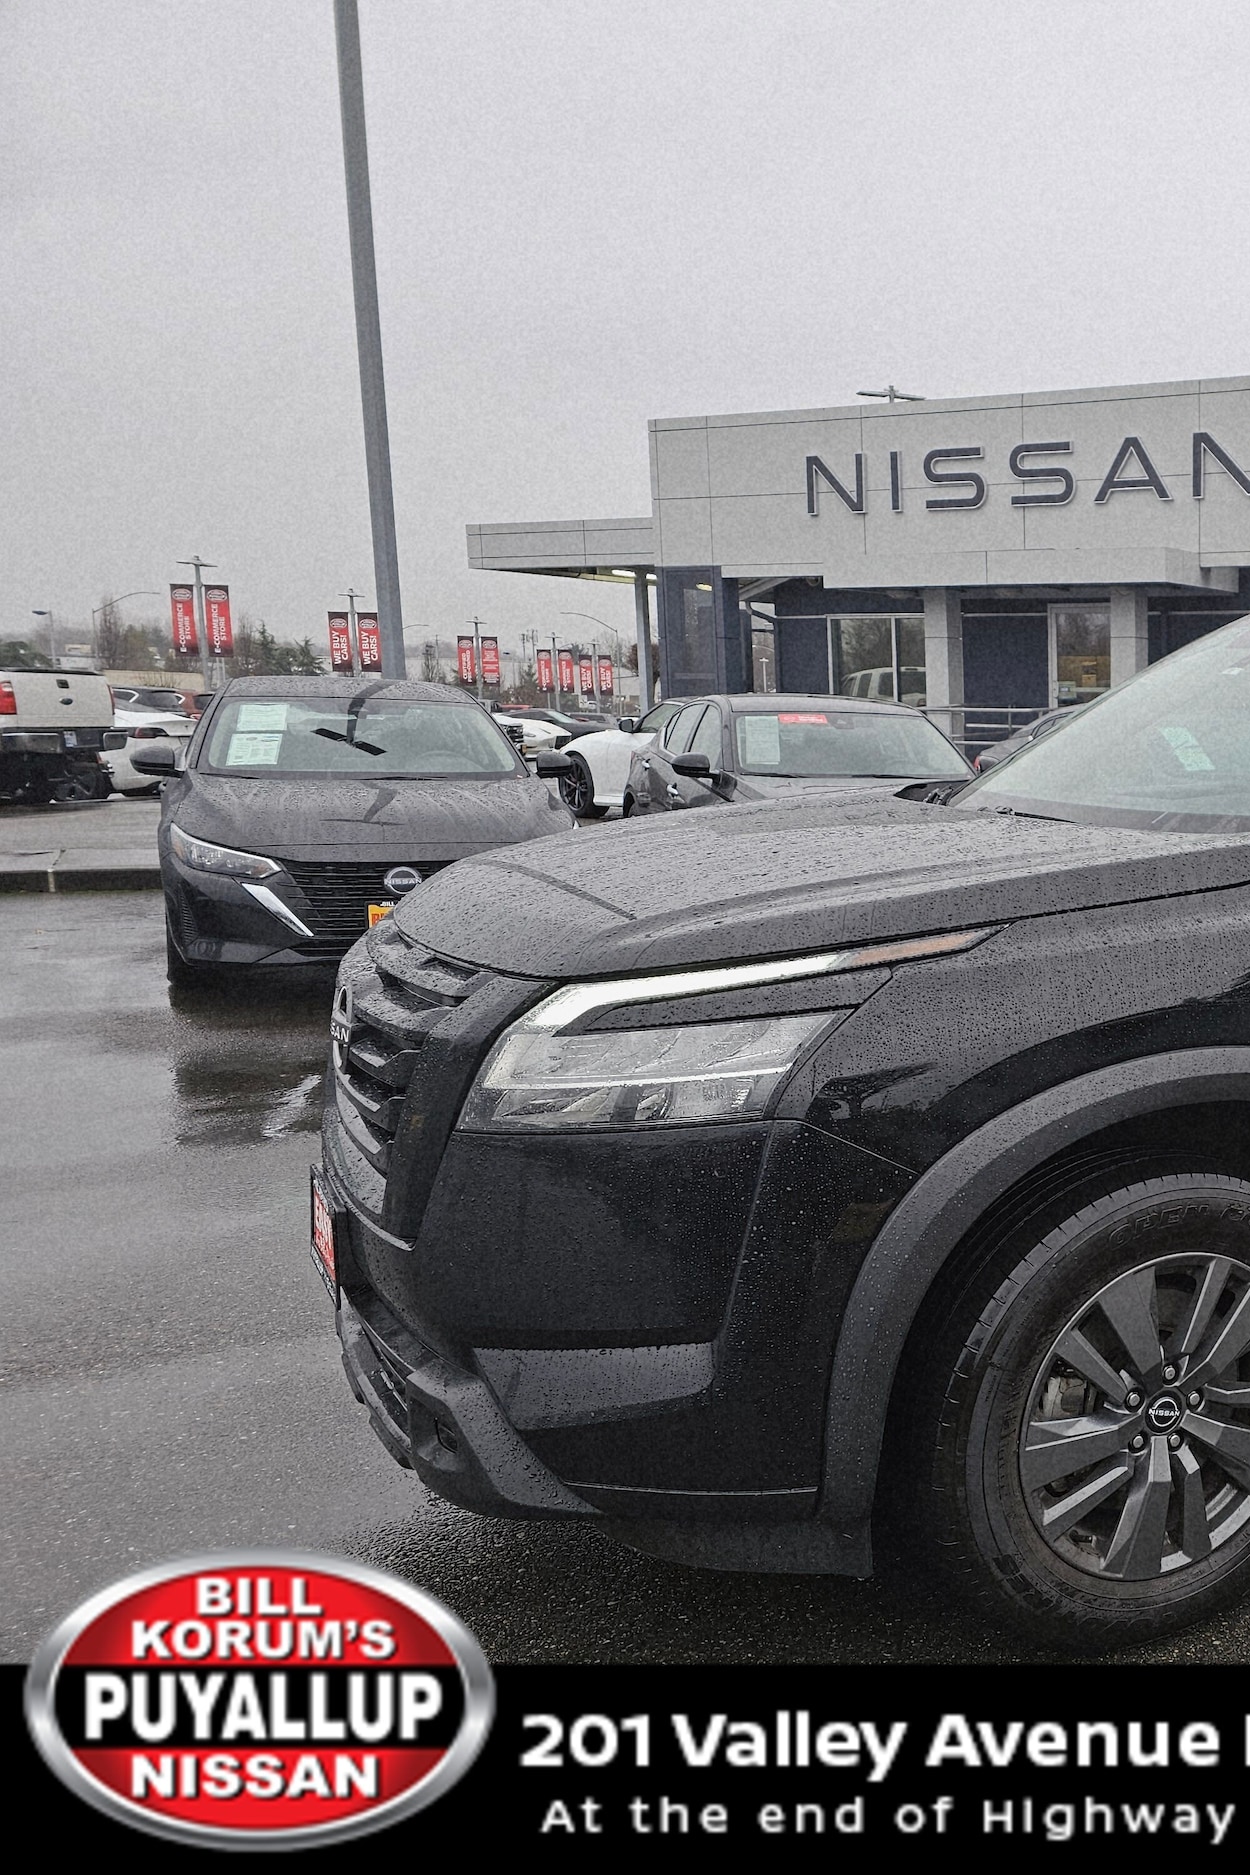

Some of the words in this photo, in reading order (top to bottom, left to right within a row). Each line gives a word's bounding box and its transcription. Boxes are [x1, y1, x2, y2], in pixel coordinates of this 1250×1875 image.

[176, 602, 187, 653] E-COMMERCE
[184, 615, 192, 640] STORE
[211, 603, 222, 653] E-COMMERCE
[218, 616, 227, 641] STORE
[332, 631, 341, 649] BUY
[340, 634, 349, 661] CARS!
[361, 631, 369, 649] BUY
[369, 635, 378, 661] CARS!
[333, 650, 342, 665] WE
[362, 650, 371, 665] WE
[384, 878, 422, 886] NISSAN
[1148, 1408, 1180, 1417] NISSAN
